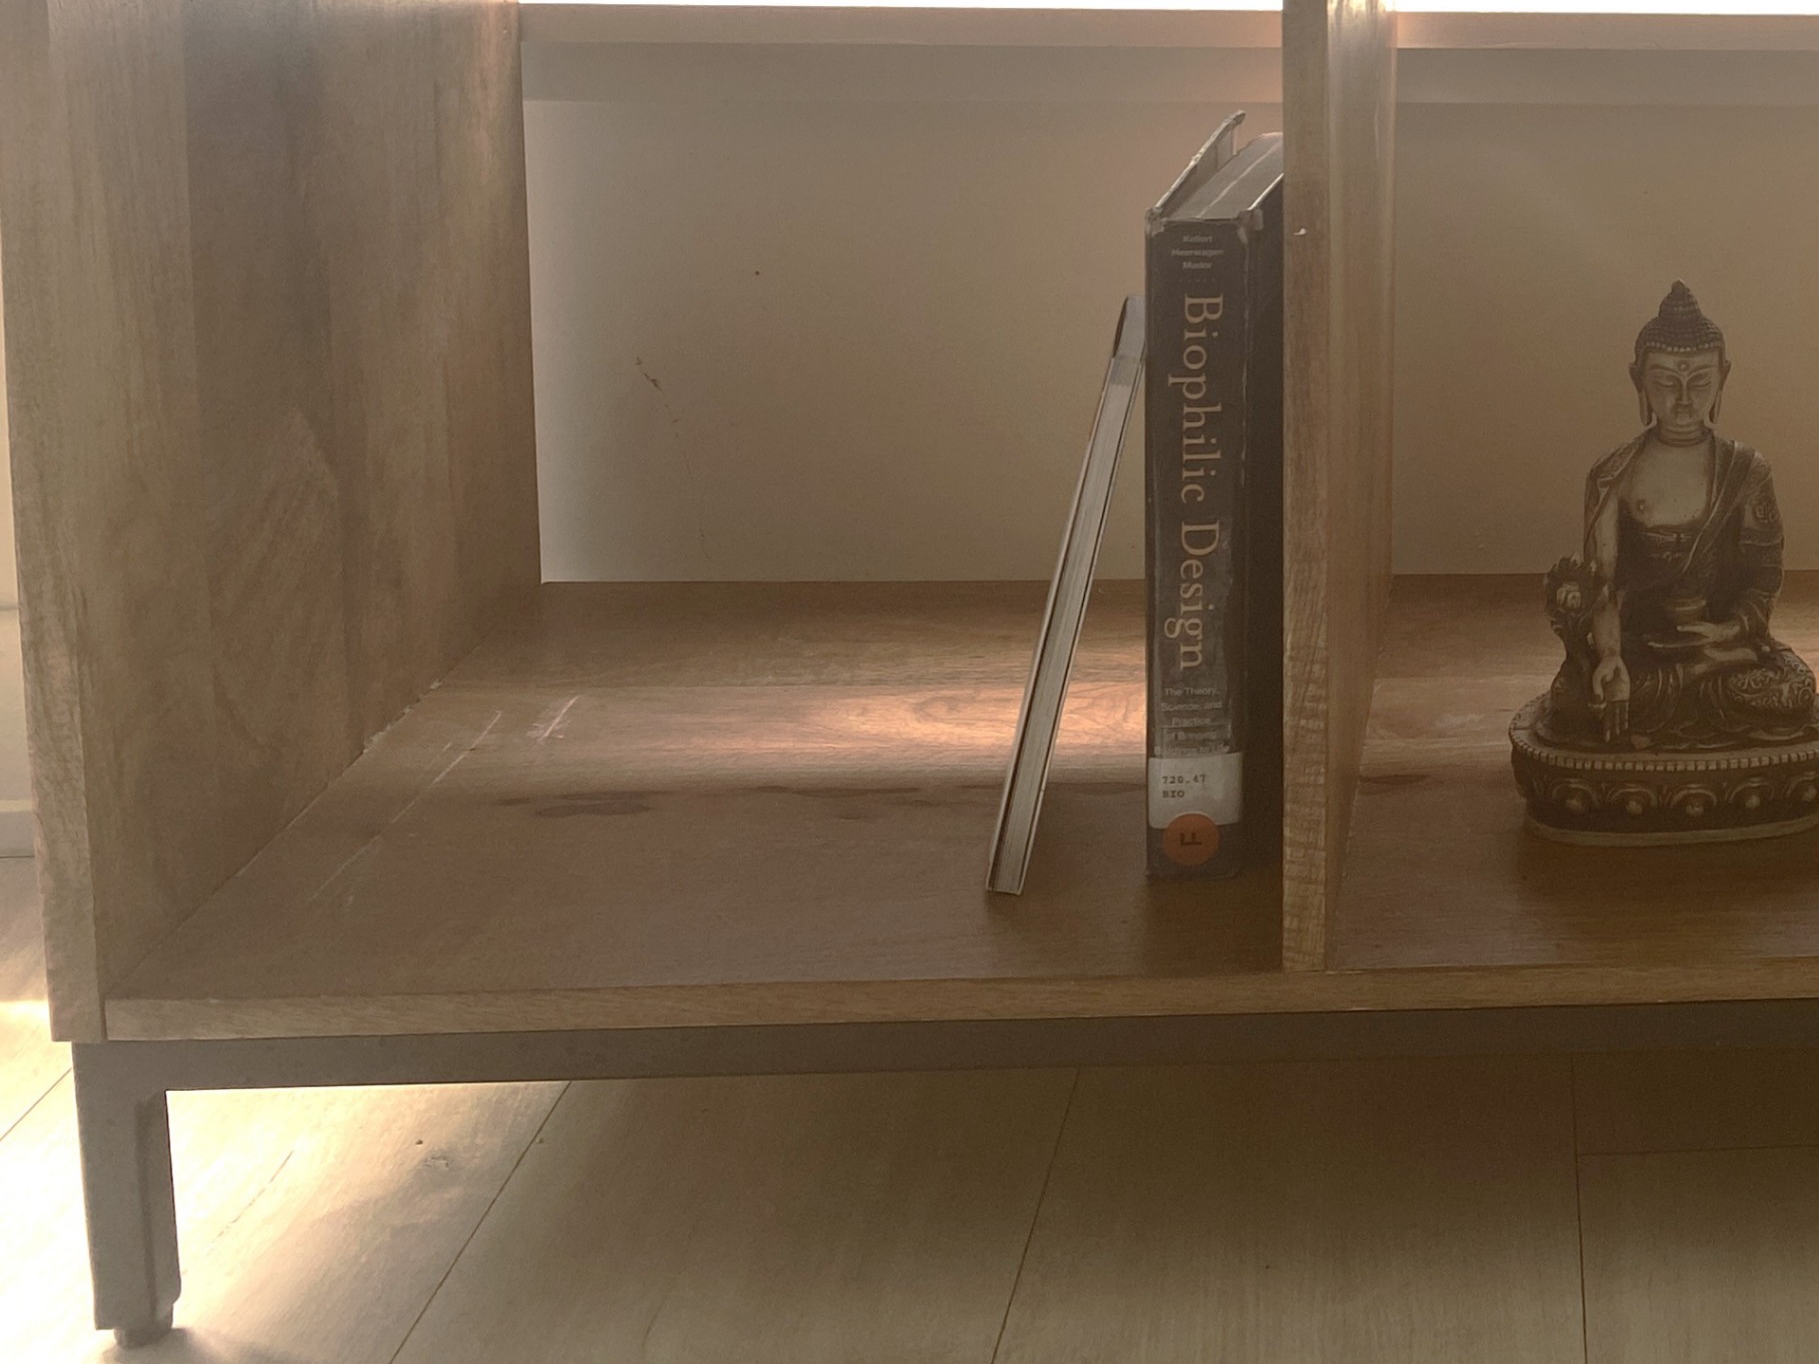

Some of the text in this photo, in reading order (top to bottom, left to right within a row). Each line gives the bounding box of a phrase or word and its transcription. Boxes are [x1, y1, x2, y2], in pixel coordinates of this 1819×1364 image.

[1164, 292, 1224, 671] Biophilic Design
[1162, 774, 1207, 785] 720.47
[1162, 790, 1185, 798] BIO
